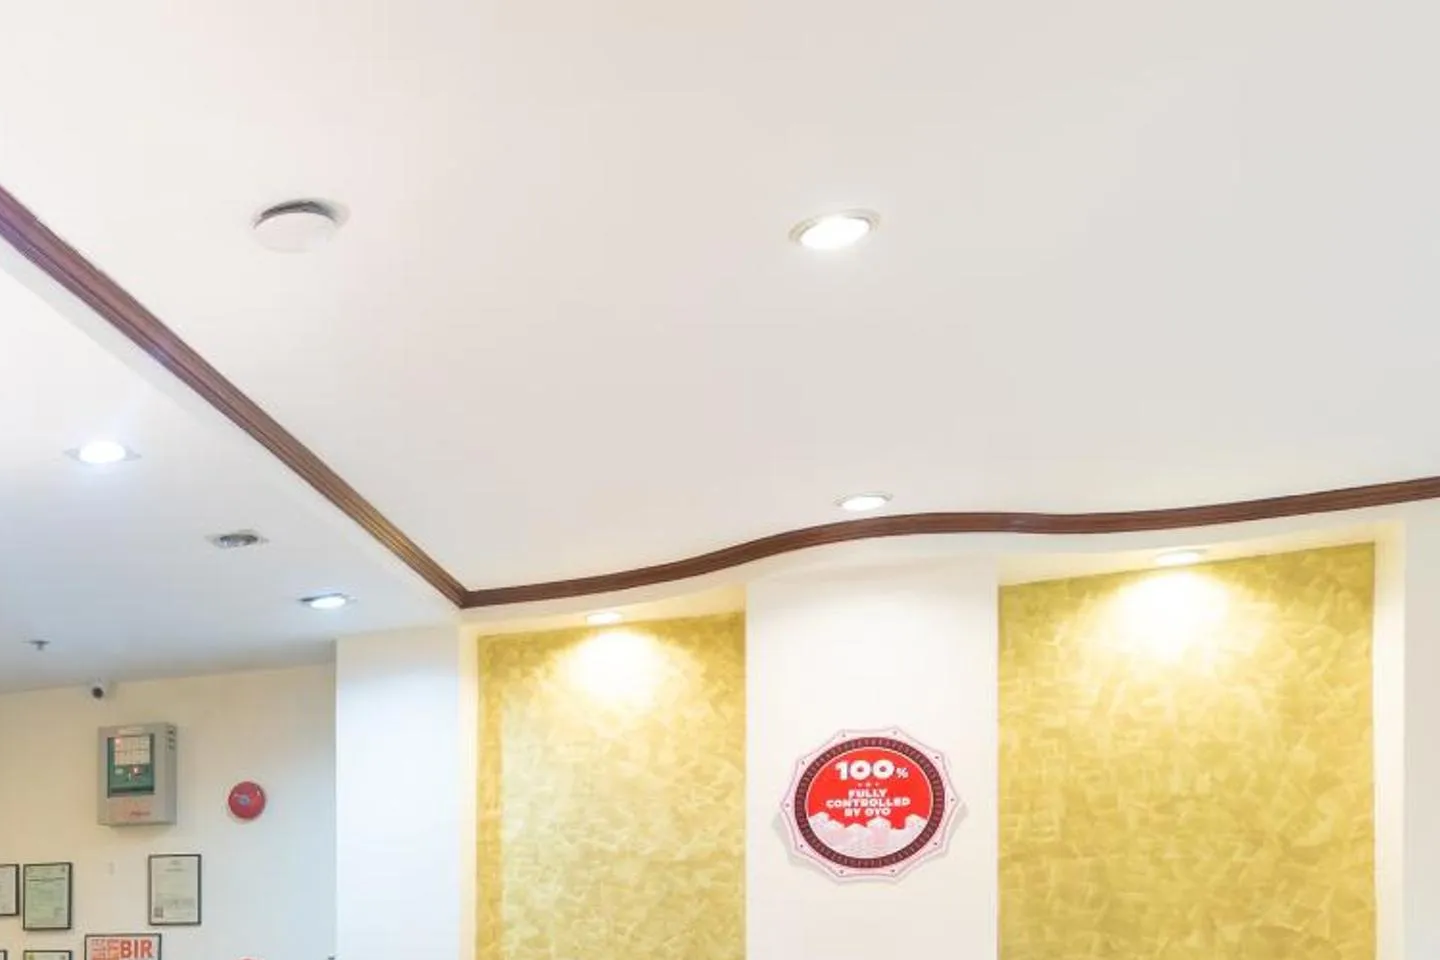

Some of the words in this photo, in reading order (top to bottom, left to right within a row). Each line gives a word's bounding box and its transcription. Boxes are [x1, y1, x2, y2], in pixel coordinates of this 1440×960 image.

[847, 788, 889, 799] FULLY
[825, 796, 912, 809] CONTROLLED
[844, 807, 861, 817] BY
[864, 807, 892, 816] OYO
[120, 938, 155, 959] BIR
